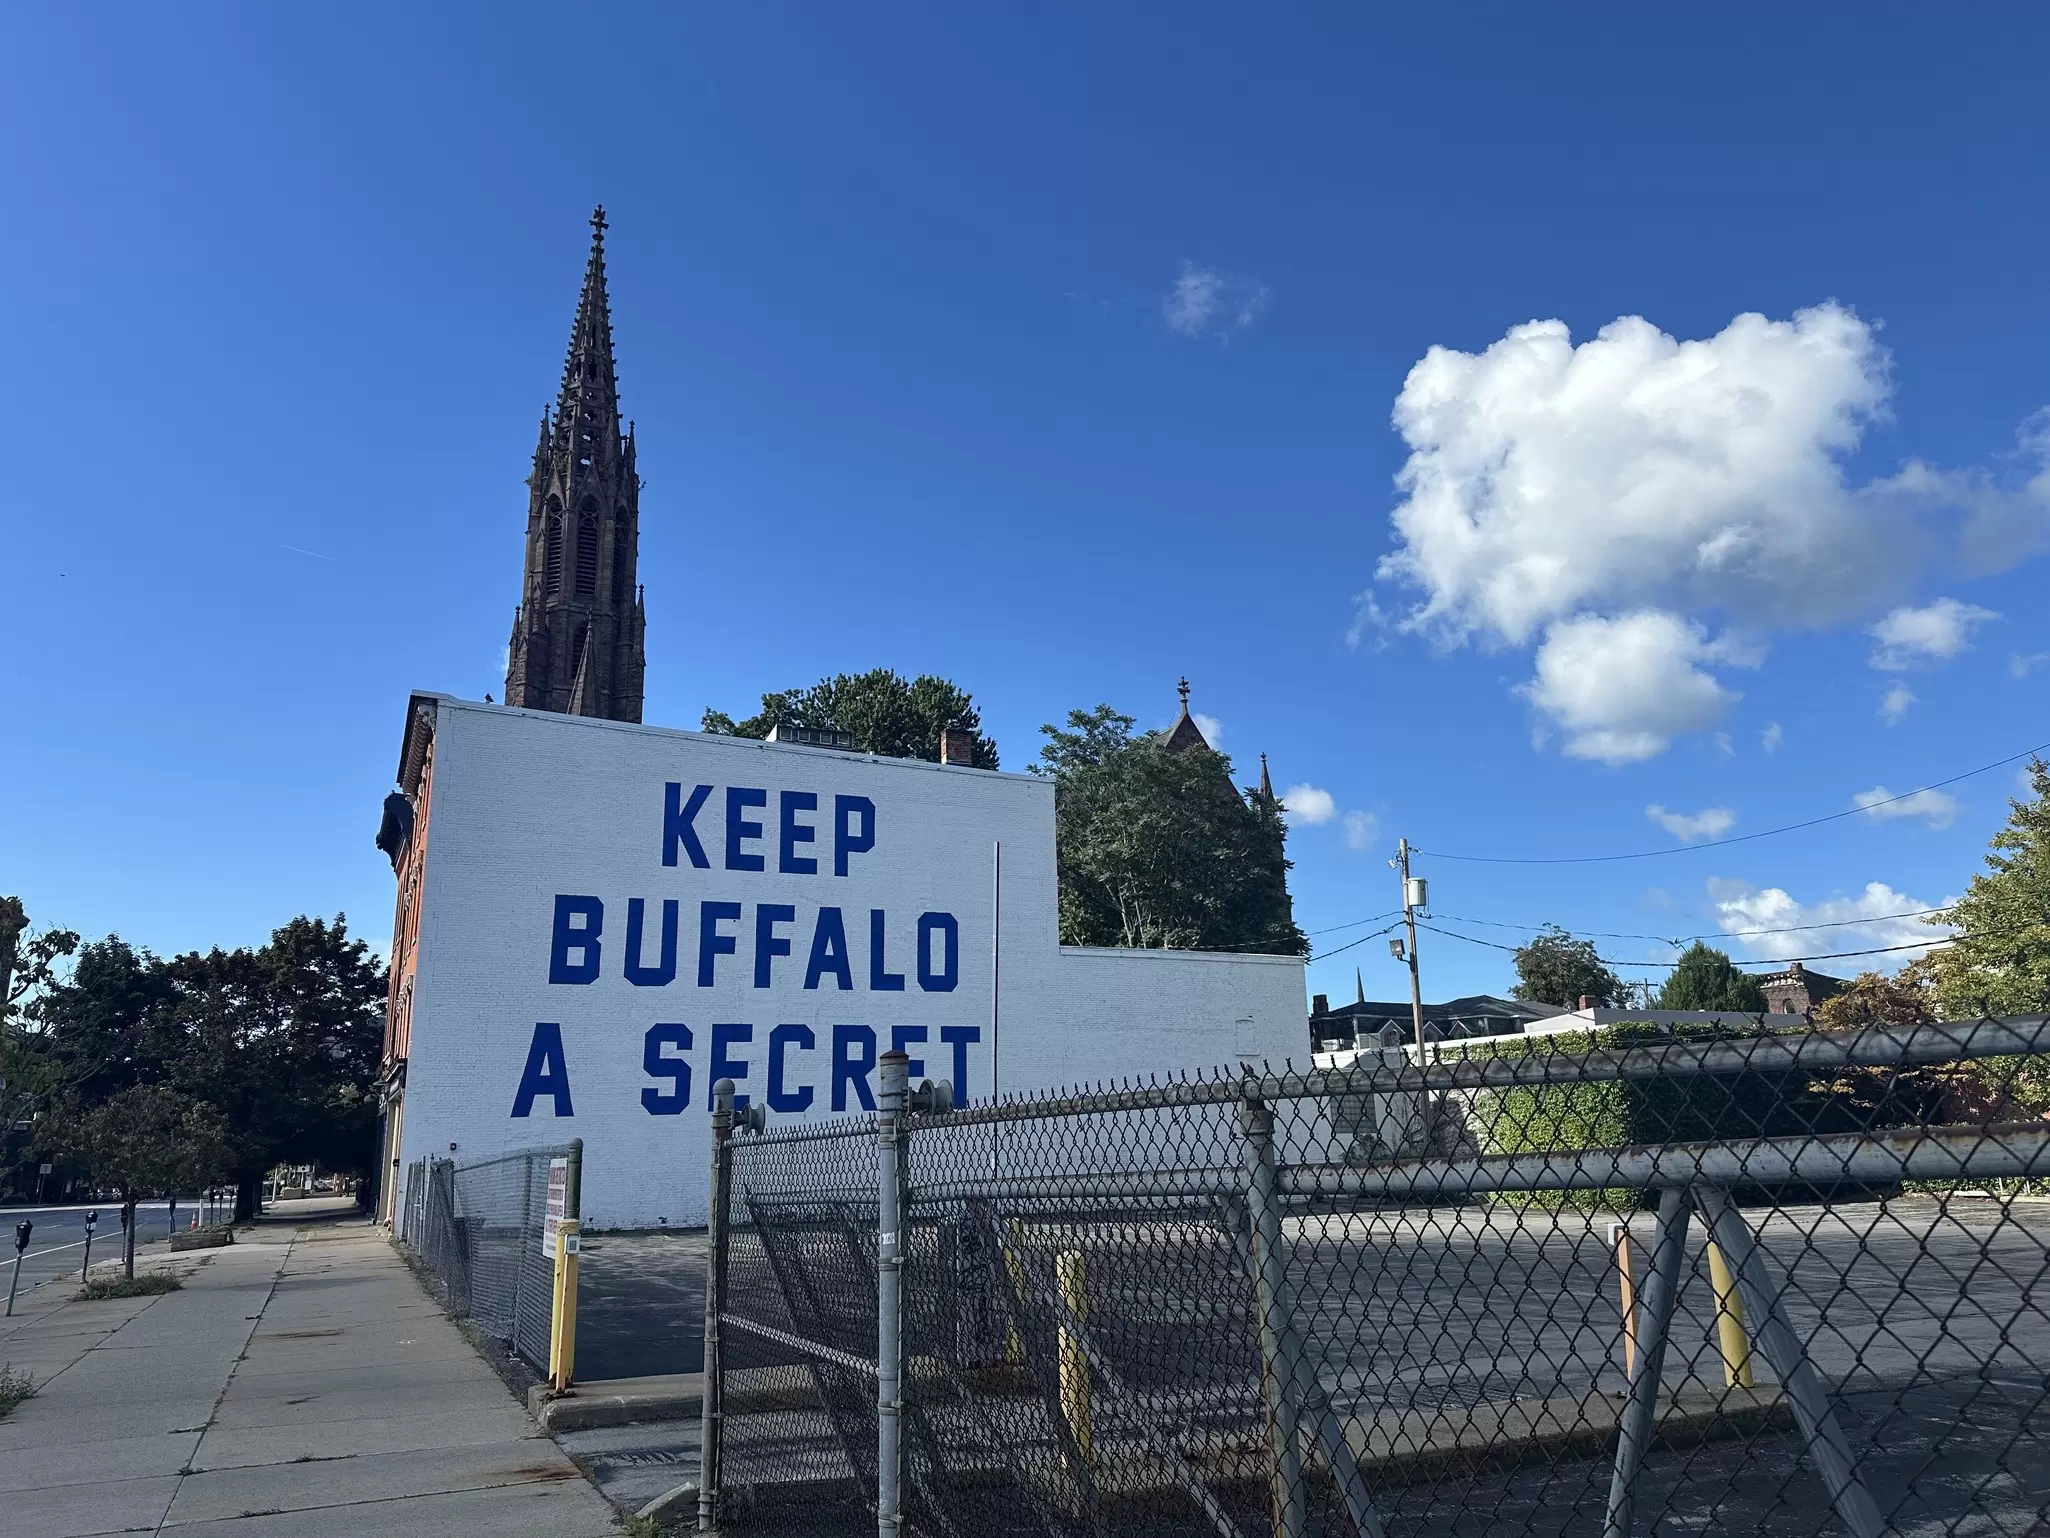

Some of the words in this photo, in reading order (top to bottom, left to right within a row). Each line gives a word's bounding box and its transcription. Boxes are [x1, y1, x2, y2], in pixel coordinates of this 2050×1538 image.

[662, 782, 876, 877] KEEP
[549, 895, 959, 992] BUFFALO
[511, 1022, 574, 1117] A
